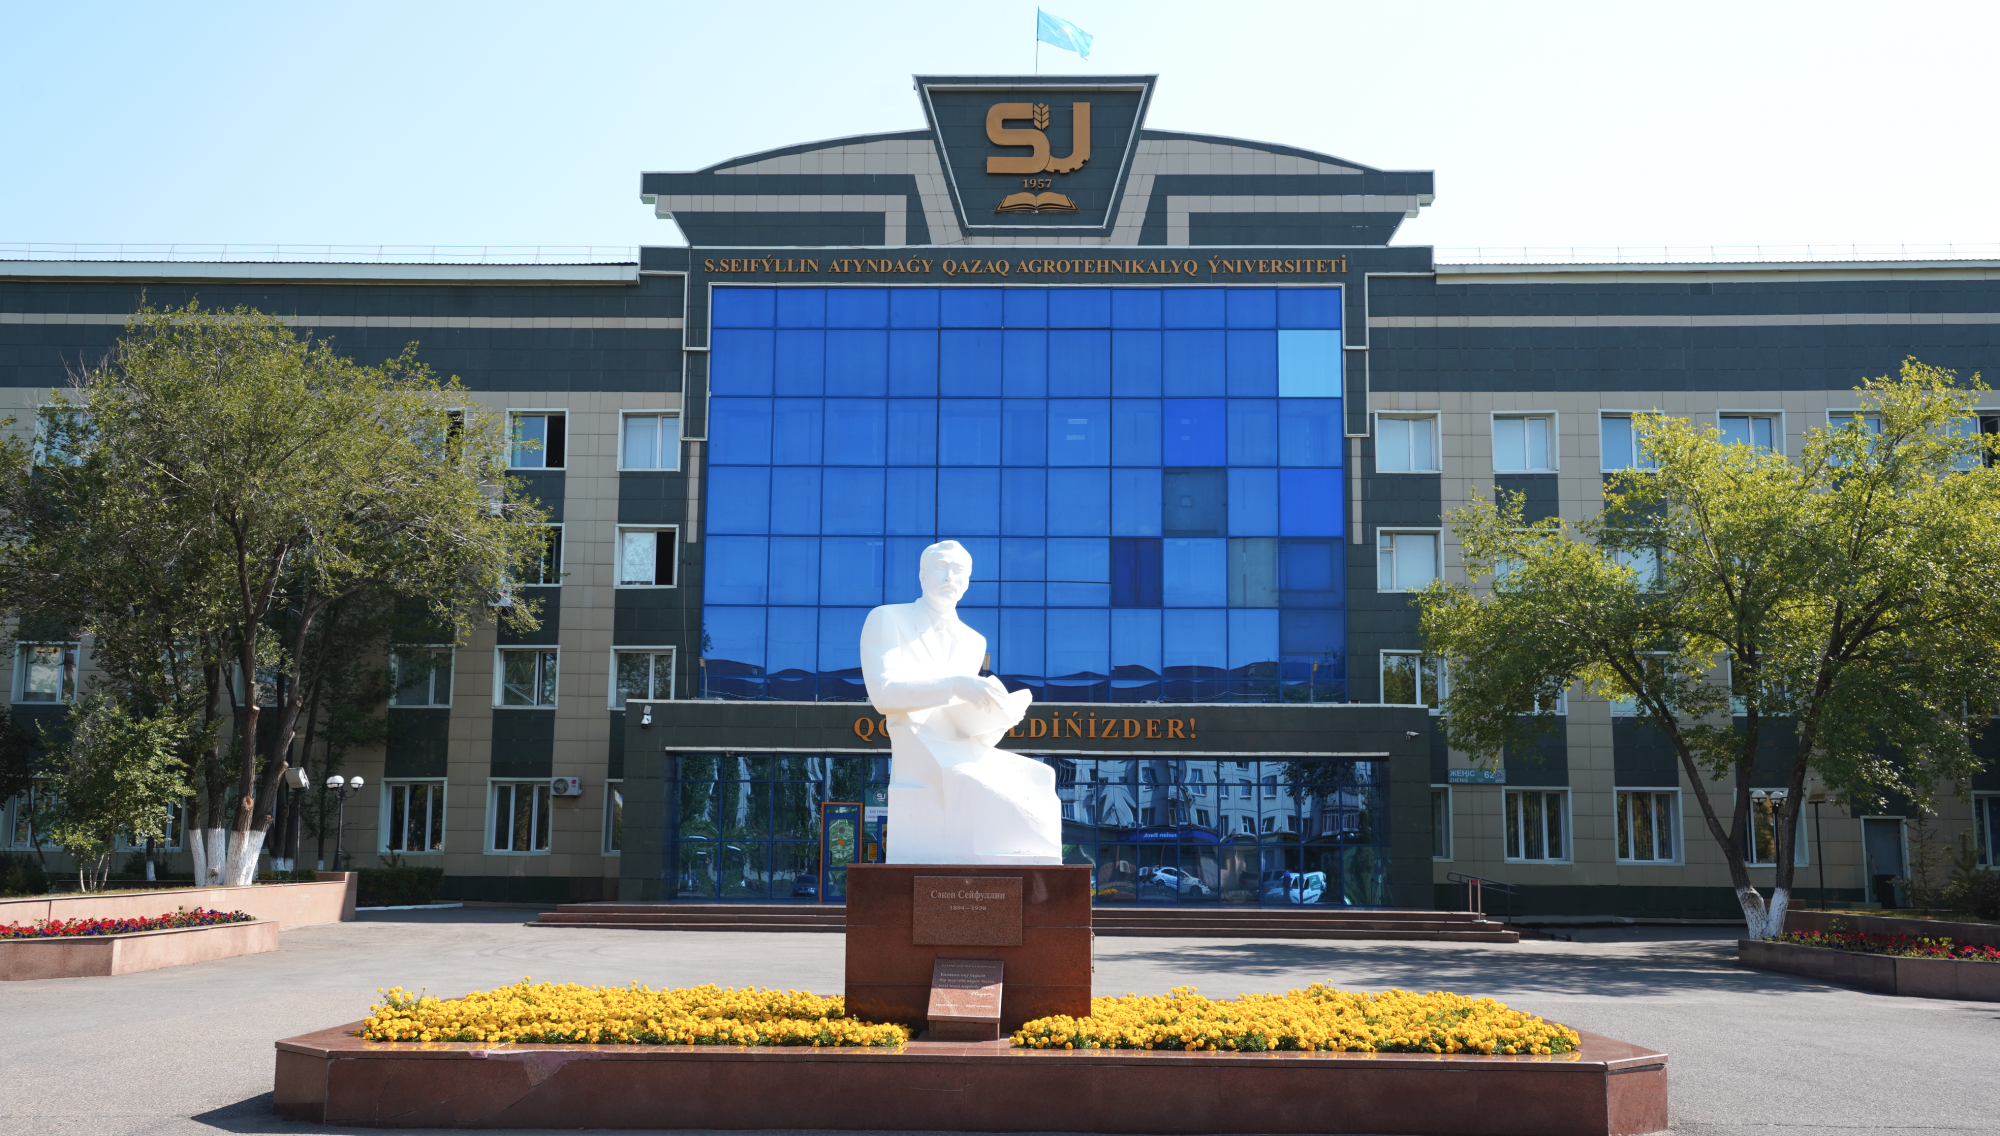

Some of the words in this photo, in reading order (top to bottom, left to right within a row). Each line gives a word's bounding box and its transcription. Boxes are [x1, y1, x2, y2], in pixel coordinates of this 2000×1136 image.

[1022, 179, 1052, 189] 1957
[704, 254, 819, 273] S.SEIFÝLLIN
[828, 254, 934, 273] ATYNDAǴY
[942, 259, 1010, 277] QAZAQ
[1016, 259, 1198, 277] AGROTEHNIKALYQ
[1484, 771, 1495, 779] 62
[958, 890, 1005, 901] Сейфуллин
